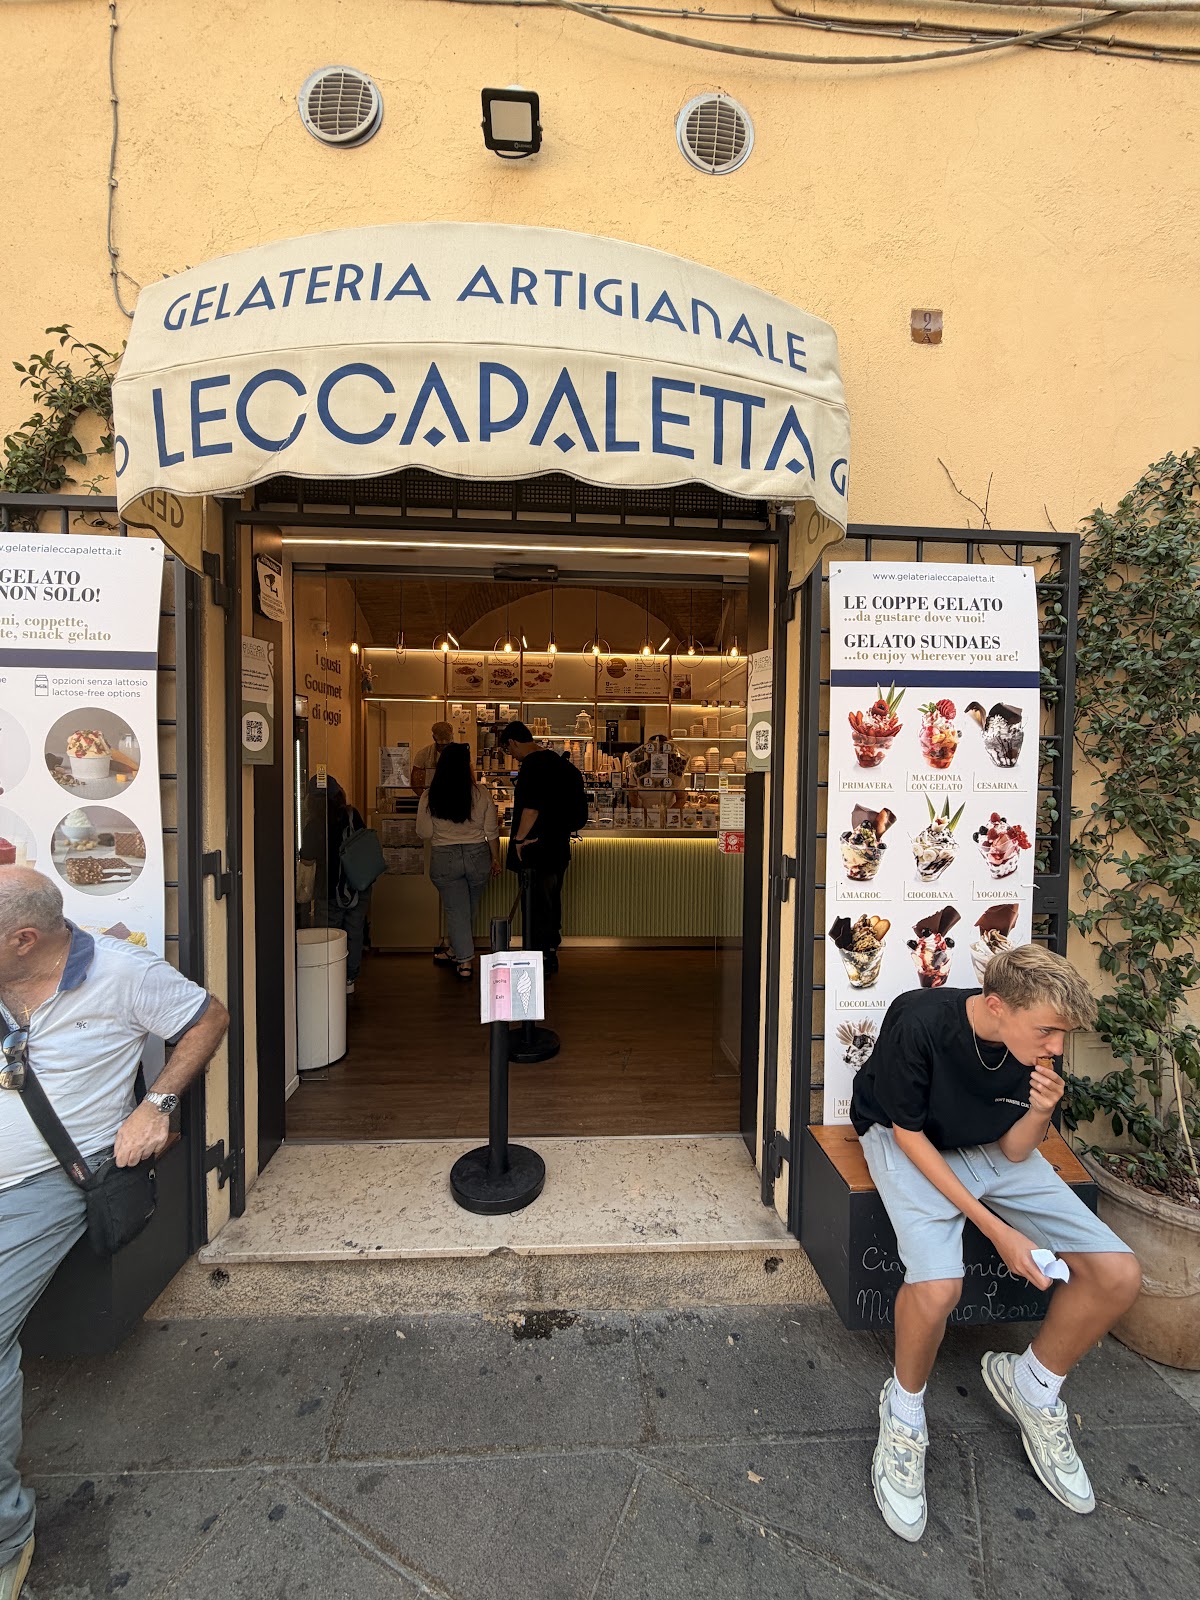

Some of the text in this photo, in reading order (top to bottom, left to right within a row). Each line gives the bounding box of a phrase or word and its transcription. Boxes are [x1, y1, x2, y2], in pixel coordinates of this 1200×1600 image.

[163, 262, 808, 373] GELATERIA ARTIGIANALE
[152, 360, 817, 482] LECCAPALETTA
[872, 571, 996, 584] www.gelaterialeccapaletta.it
[43, 587, 101, 603] SOLO!
[843, 595, 1004, 613] LE COPPE GELATO
[24, 618, 90, 632] coppette,
[843, 612, 986, 626] ...da gustare dove vuoi!
[22, 628, 65, 641] snack
[68, 625, 113, 644] gelato
[844, 634, 1002, 651] GELATO SUNDAES
[844, 650, 1020, 665] ...to enjoy wherever you are!
[320, 656, 342, 675] gusti
[52, 677, 149, 688] opzioni senza lattosio
[304, 673, 343, 700] Gourmet
[52, 688, 142, 699] lactose-free options
[312, 703, 342, 727] di oggi
[911, 774, 962, 782] MACEDONIA
[842, 781, 893, 790] PRIMAVERA
[929, 783, 963, 791] GELATO
[976, 782, 1018, 790] CESARINA
[976, 891, 1019, 899] YOGOLOSA
[839, 1000, 886, 1008] COCCOLAMI
